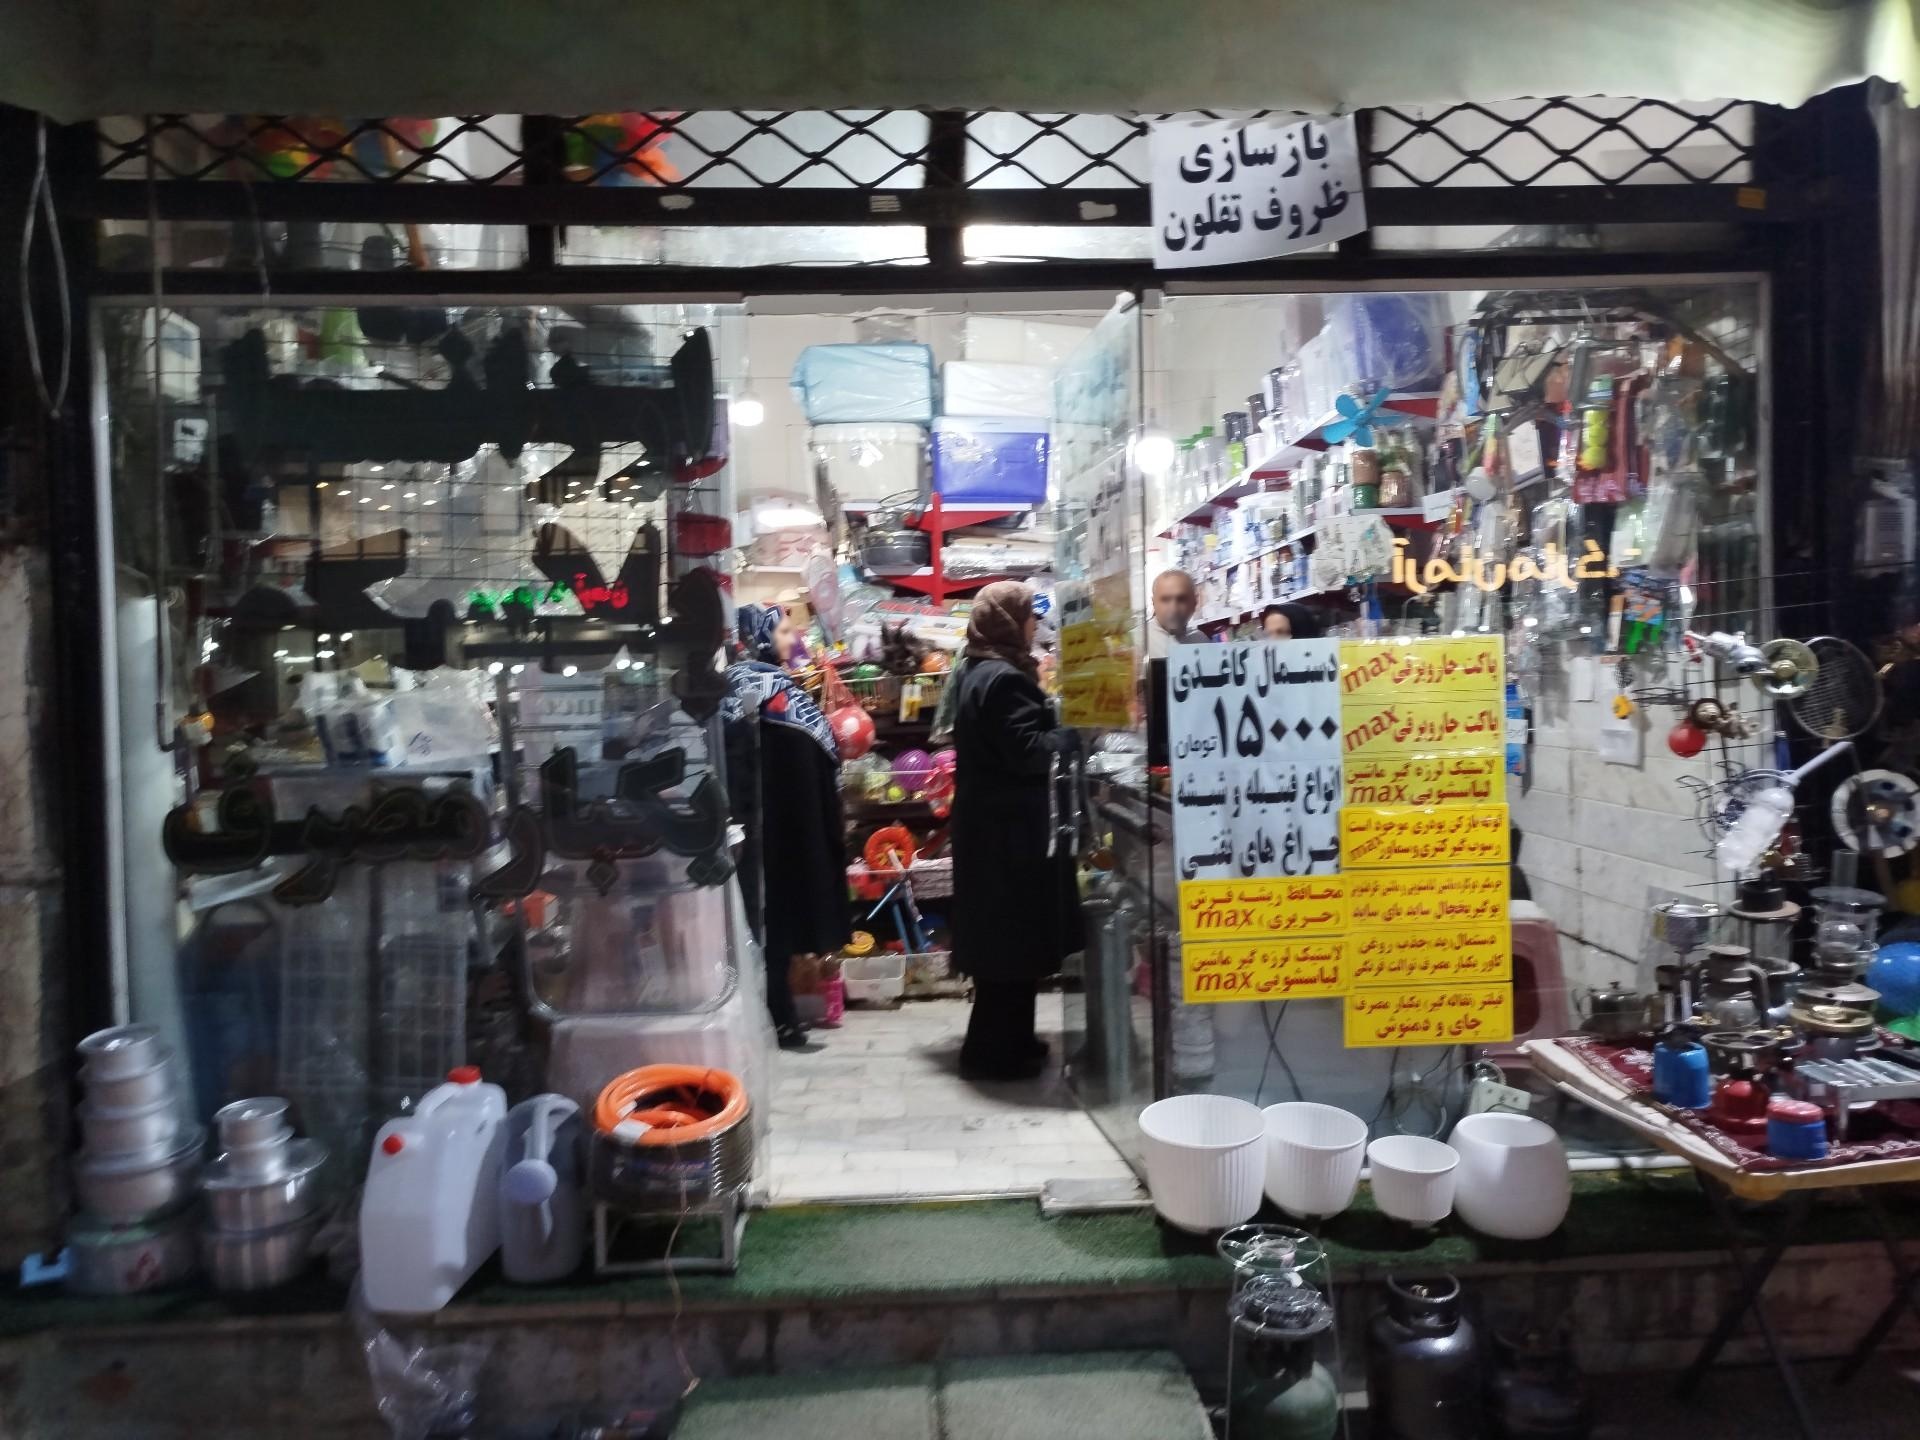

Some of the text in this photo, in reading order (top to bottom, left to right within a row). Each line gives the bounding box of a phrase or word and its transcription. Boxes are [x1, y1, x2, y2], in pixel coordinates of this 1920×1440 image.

[1253, 181, 1350, 240] ظروف
[1173, 648, 1250, 702] کاغذی
[1256, 645, 1337, 698] دستمال
[1343, 648, 1398, 693] max
[1464, 652, 1499, 681] پاکت
[1175, 694, 1339, 759] ۱۵۰۰۰ تومان
[1344, 705, 1400, 752] max
[1465, 710, 1499, 738] پاکت
[1347, 763, 1386, 784] ماشین
[1416, 760, 1444, 781] لرزه
[1450, 759, 1496, 779] لاستیک
[1232, 785, 1241, 817] و
[1247, 764, 1297, 813] فتیله
[1304, 765, 1341, 815] انواع
[1350, 784, 1408, 805] max
[1376, 821, 1409, 836] موجود
[1182, 823, 1340, 880] چراغ های نفتی
[1189, 887, 1233, 910] فرش
[1239, 887, 1282, 907] ریشه
[1287, 884, 1344, 901] محافظ
[1196, 908, 1256, 932] max
[1192, 944, 1343, 972] لاستیک لرزه گیر ماشین
[1195, 970, 1255, 993] max
[1376, 1013, 1482, 1038] چای و دمنوش
